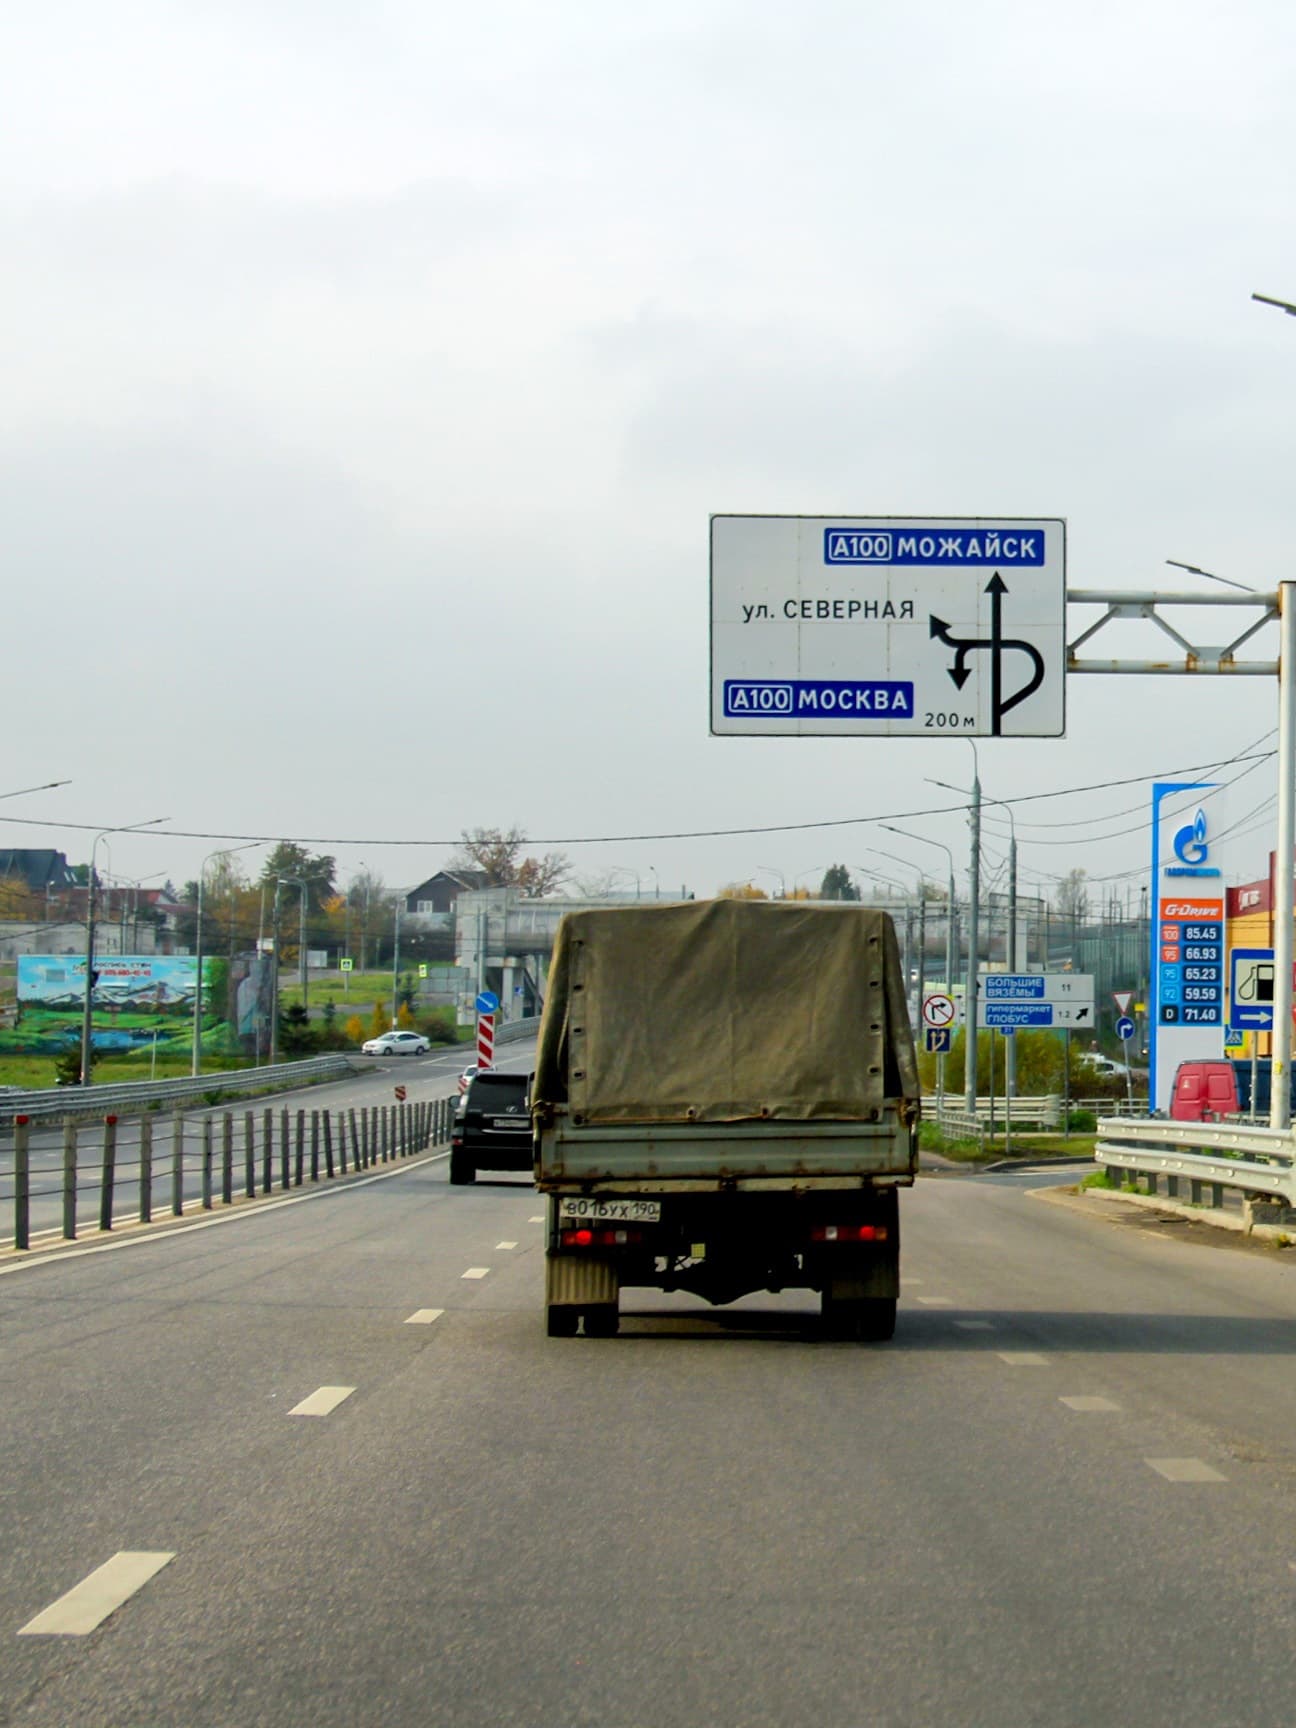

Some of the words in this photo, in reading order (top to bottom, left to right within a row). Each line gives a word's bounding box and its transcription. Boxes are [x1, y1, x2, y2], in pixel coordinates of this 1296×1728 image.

[833, 537, 889, 557] А100
[897, 532, 1036, 558] МОЖАЙСК
[742, 603, 776, 623] ул.
[783, 600, 914, 619] СЕВЕРНАЯ
[732, 689, 789, 709] А100
[798, 690, 908, 711] МОСКВА
[924, 713, 960, 728] 200
[1186, 927, 1217, 940] 85.45
[1164, 950, 1177, 961] 95
[1186, 948, 1217, 960] 66.93
[1185, 968, 1217, 980] 65.23
[987, 978, 1043, 987] БОЛЬШИЕ
[987, 987, 1036, 997] ВЯЗЁМЫ
[1185, 988, 1217, 1000] 59.59
[987, 1005, 1051, 1014] гипермаркет
[1165, 1009, 1174, 1019] D
[1185, 1008, 1217, 1021] 71.40
[987, 1014, 1030, 1023] ГЛОБУС
[632, 1203, 656, 1216] 190
